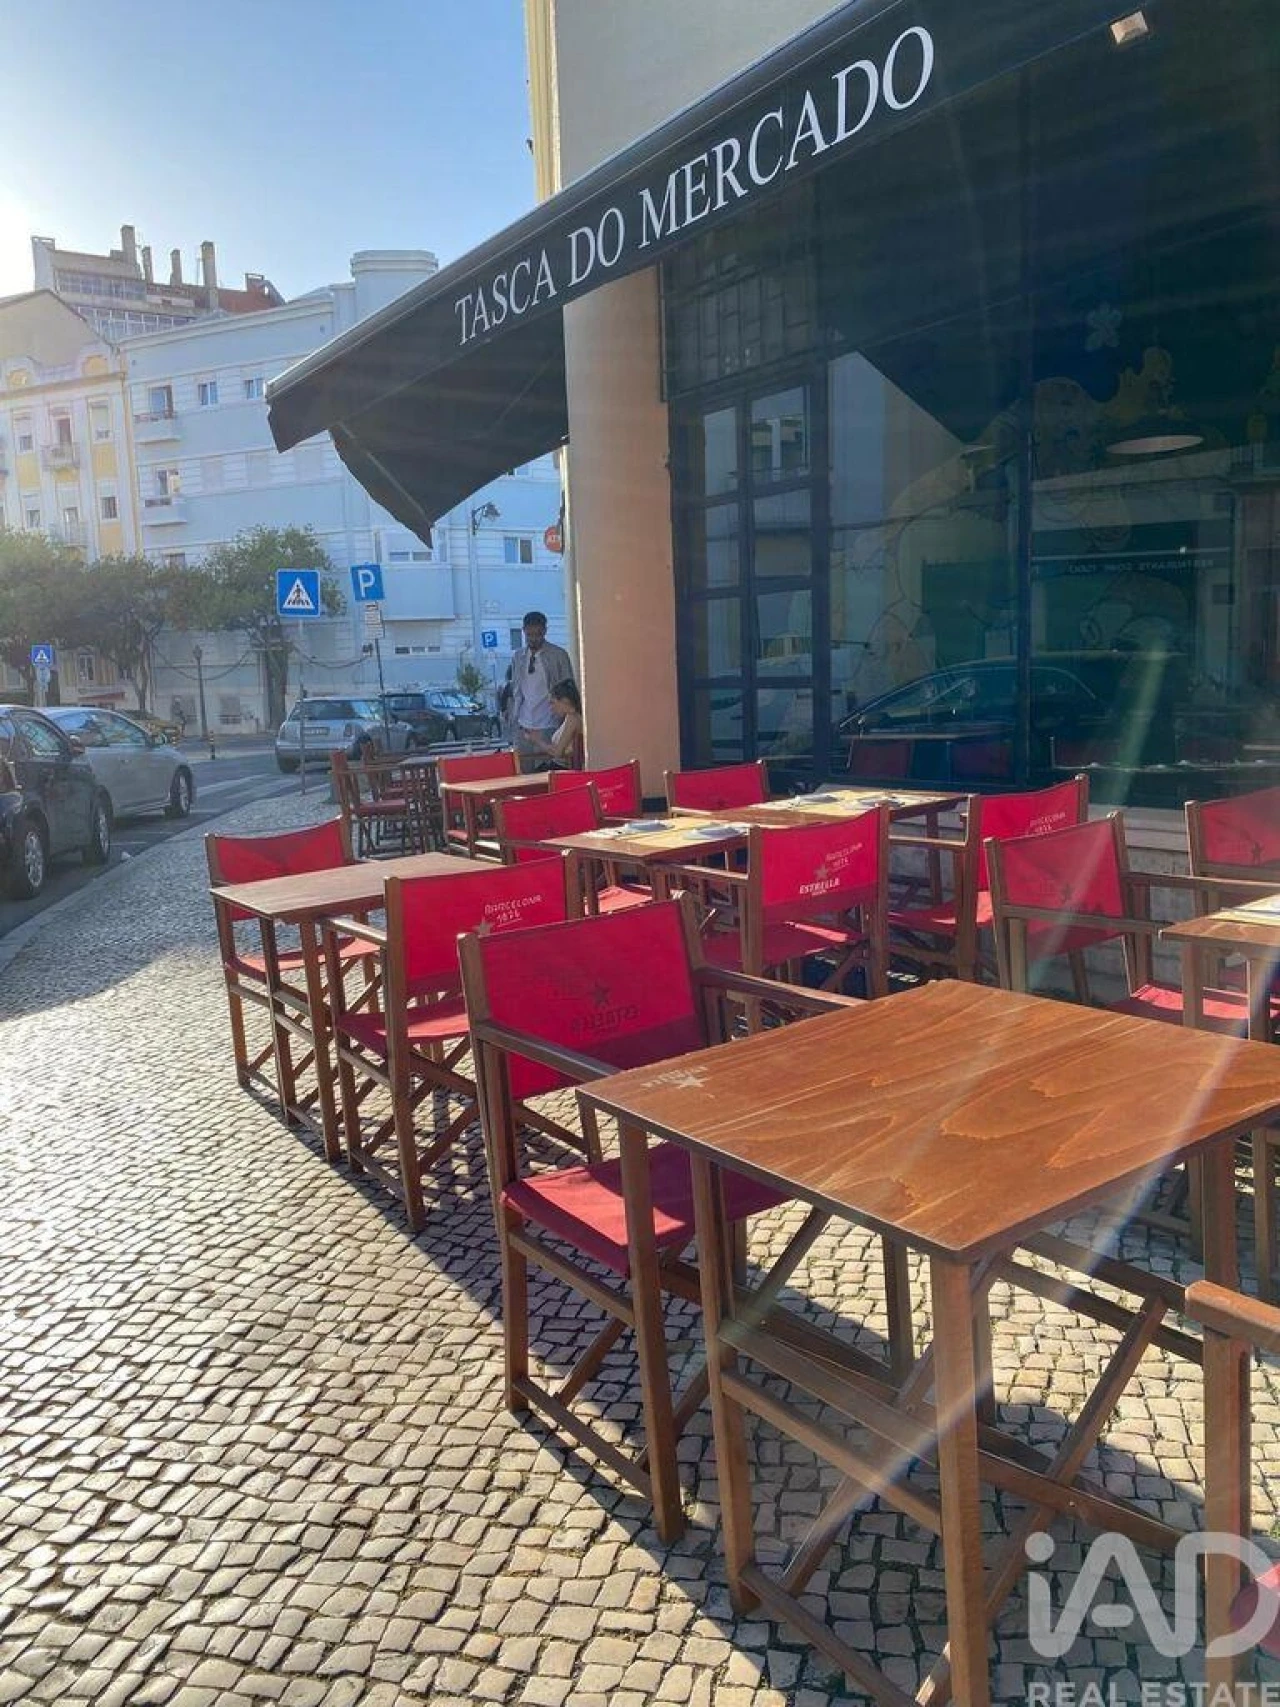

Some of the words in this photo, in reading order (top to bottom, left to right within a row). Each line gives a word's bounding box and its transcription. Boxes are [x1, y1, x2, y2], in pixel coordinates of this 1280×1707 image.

[454, 249, 558, 346] TASCA
[567, 207, 625, 287] DO
[638, 25, 935, 249] MERCADO
[358, 569, 375, 598] P
[484, 631, 495, 647] P
